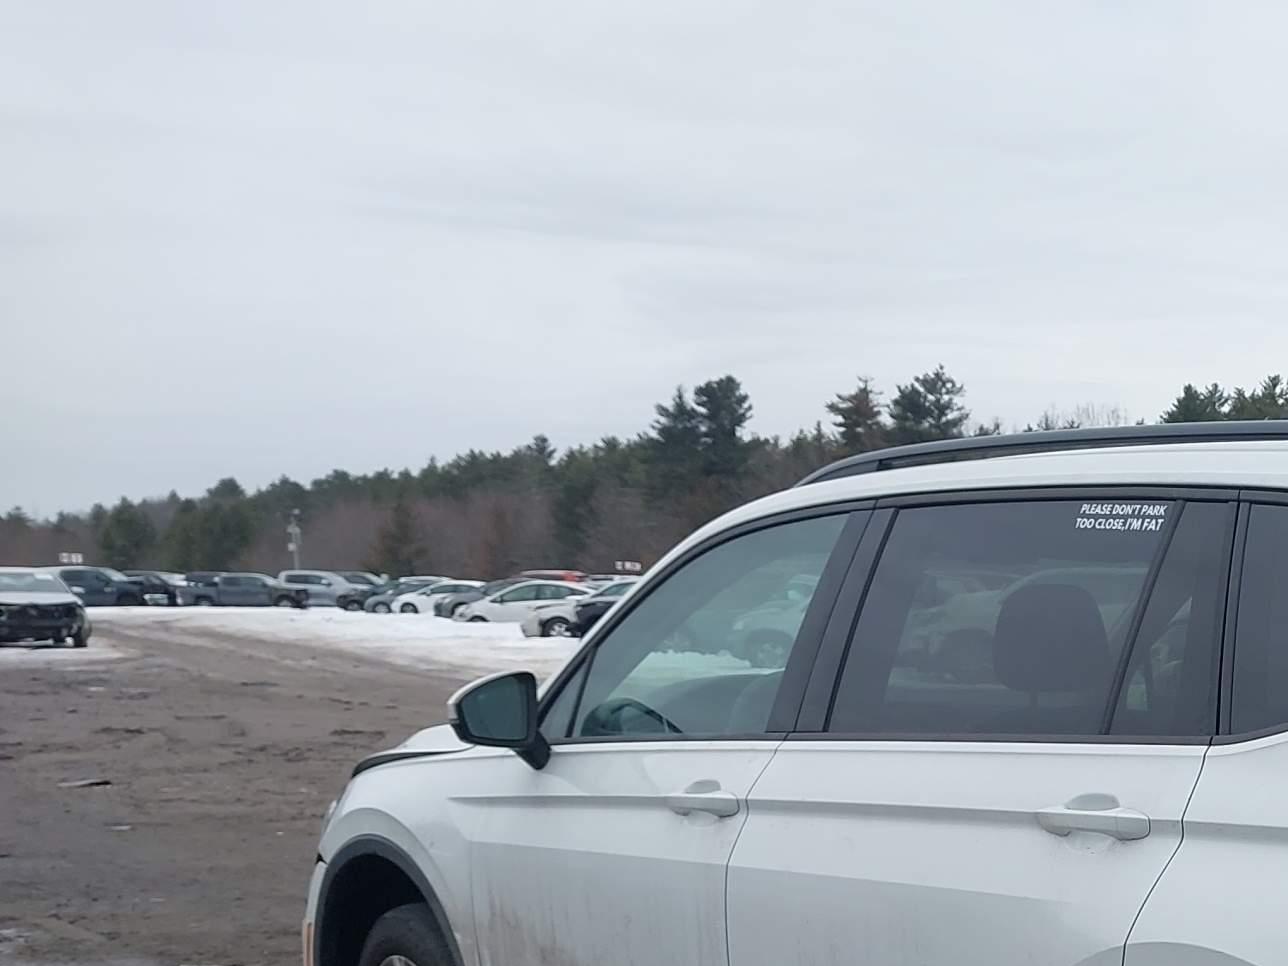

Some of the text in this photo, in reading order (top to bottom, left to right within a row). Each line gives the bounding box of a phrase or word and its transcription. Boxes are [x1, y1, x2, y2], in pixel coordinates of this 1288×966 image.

[1080, 503, 1168, 516] PLEASE DON'T PARK
[1075, 517, 1095, 529] TOO
[1142, 518, 1164, 531] FAT
